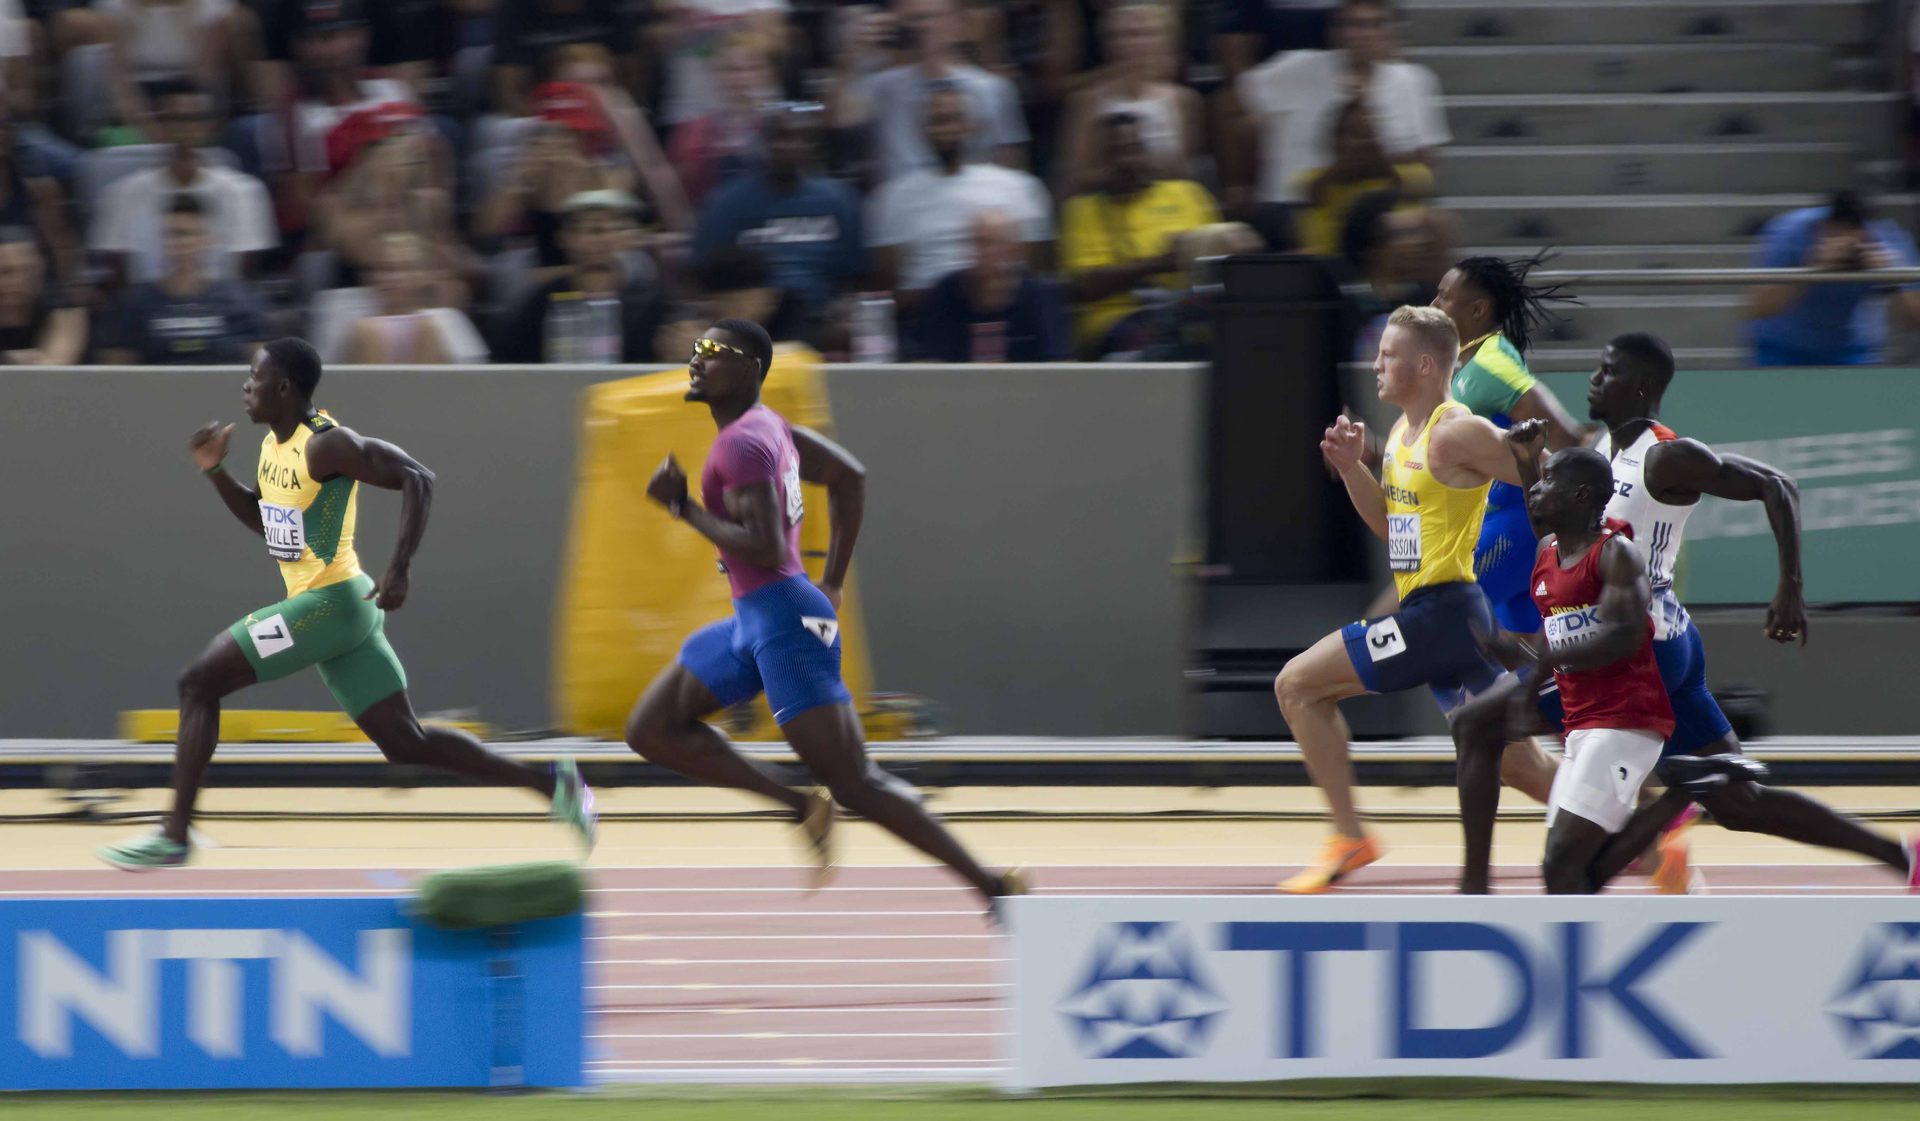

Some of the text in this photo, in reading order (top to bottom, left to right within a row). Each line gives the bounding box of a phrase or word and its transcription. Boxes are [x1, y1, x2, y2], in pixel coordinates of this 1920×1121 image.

[259, 459, 302, 490] MAICA
[263, 505, 297, 526] TDK
[1390, 517, 1415, 534] TDK
[1557, 607, 1602, 634] TDK
[257, 625, 284, 641] 7
[1371, 632, 1397, 649] 5
[17, 928, 412, 1059] NTN
[1216, 921, 1722, 1060] TDK
